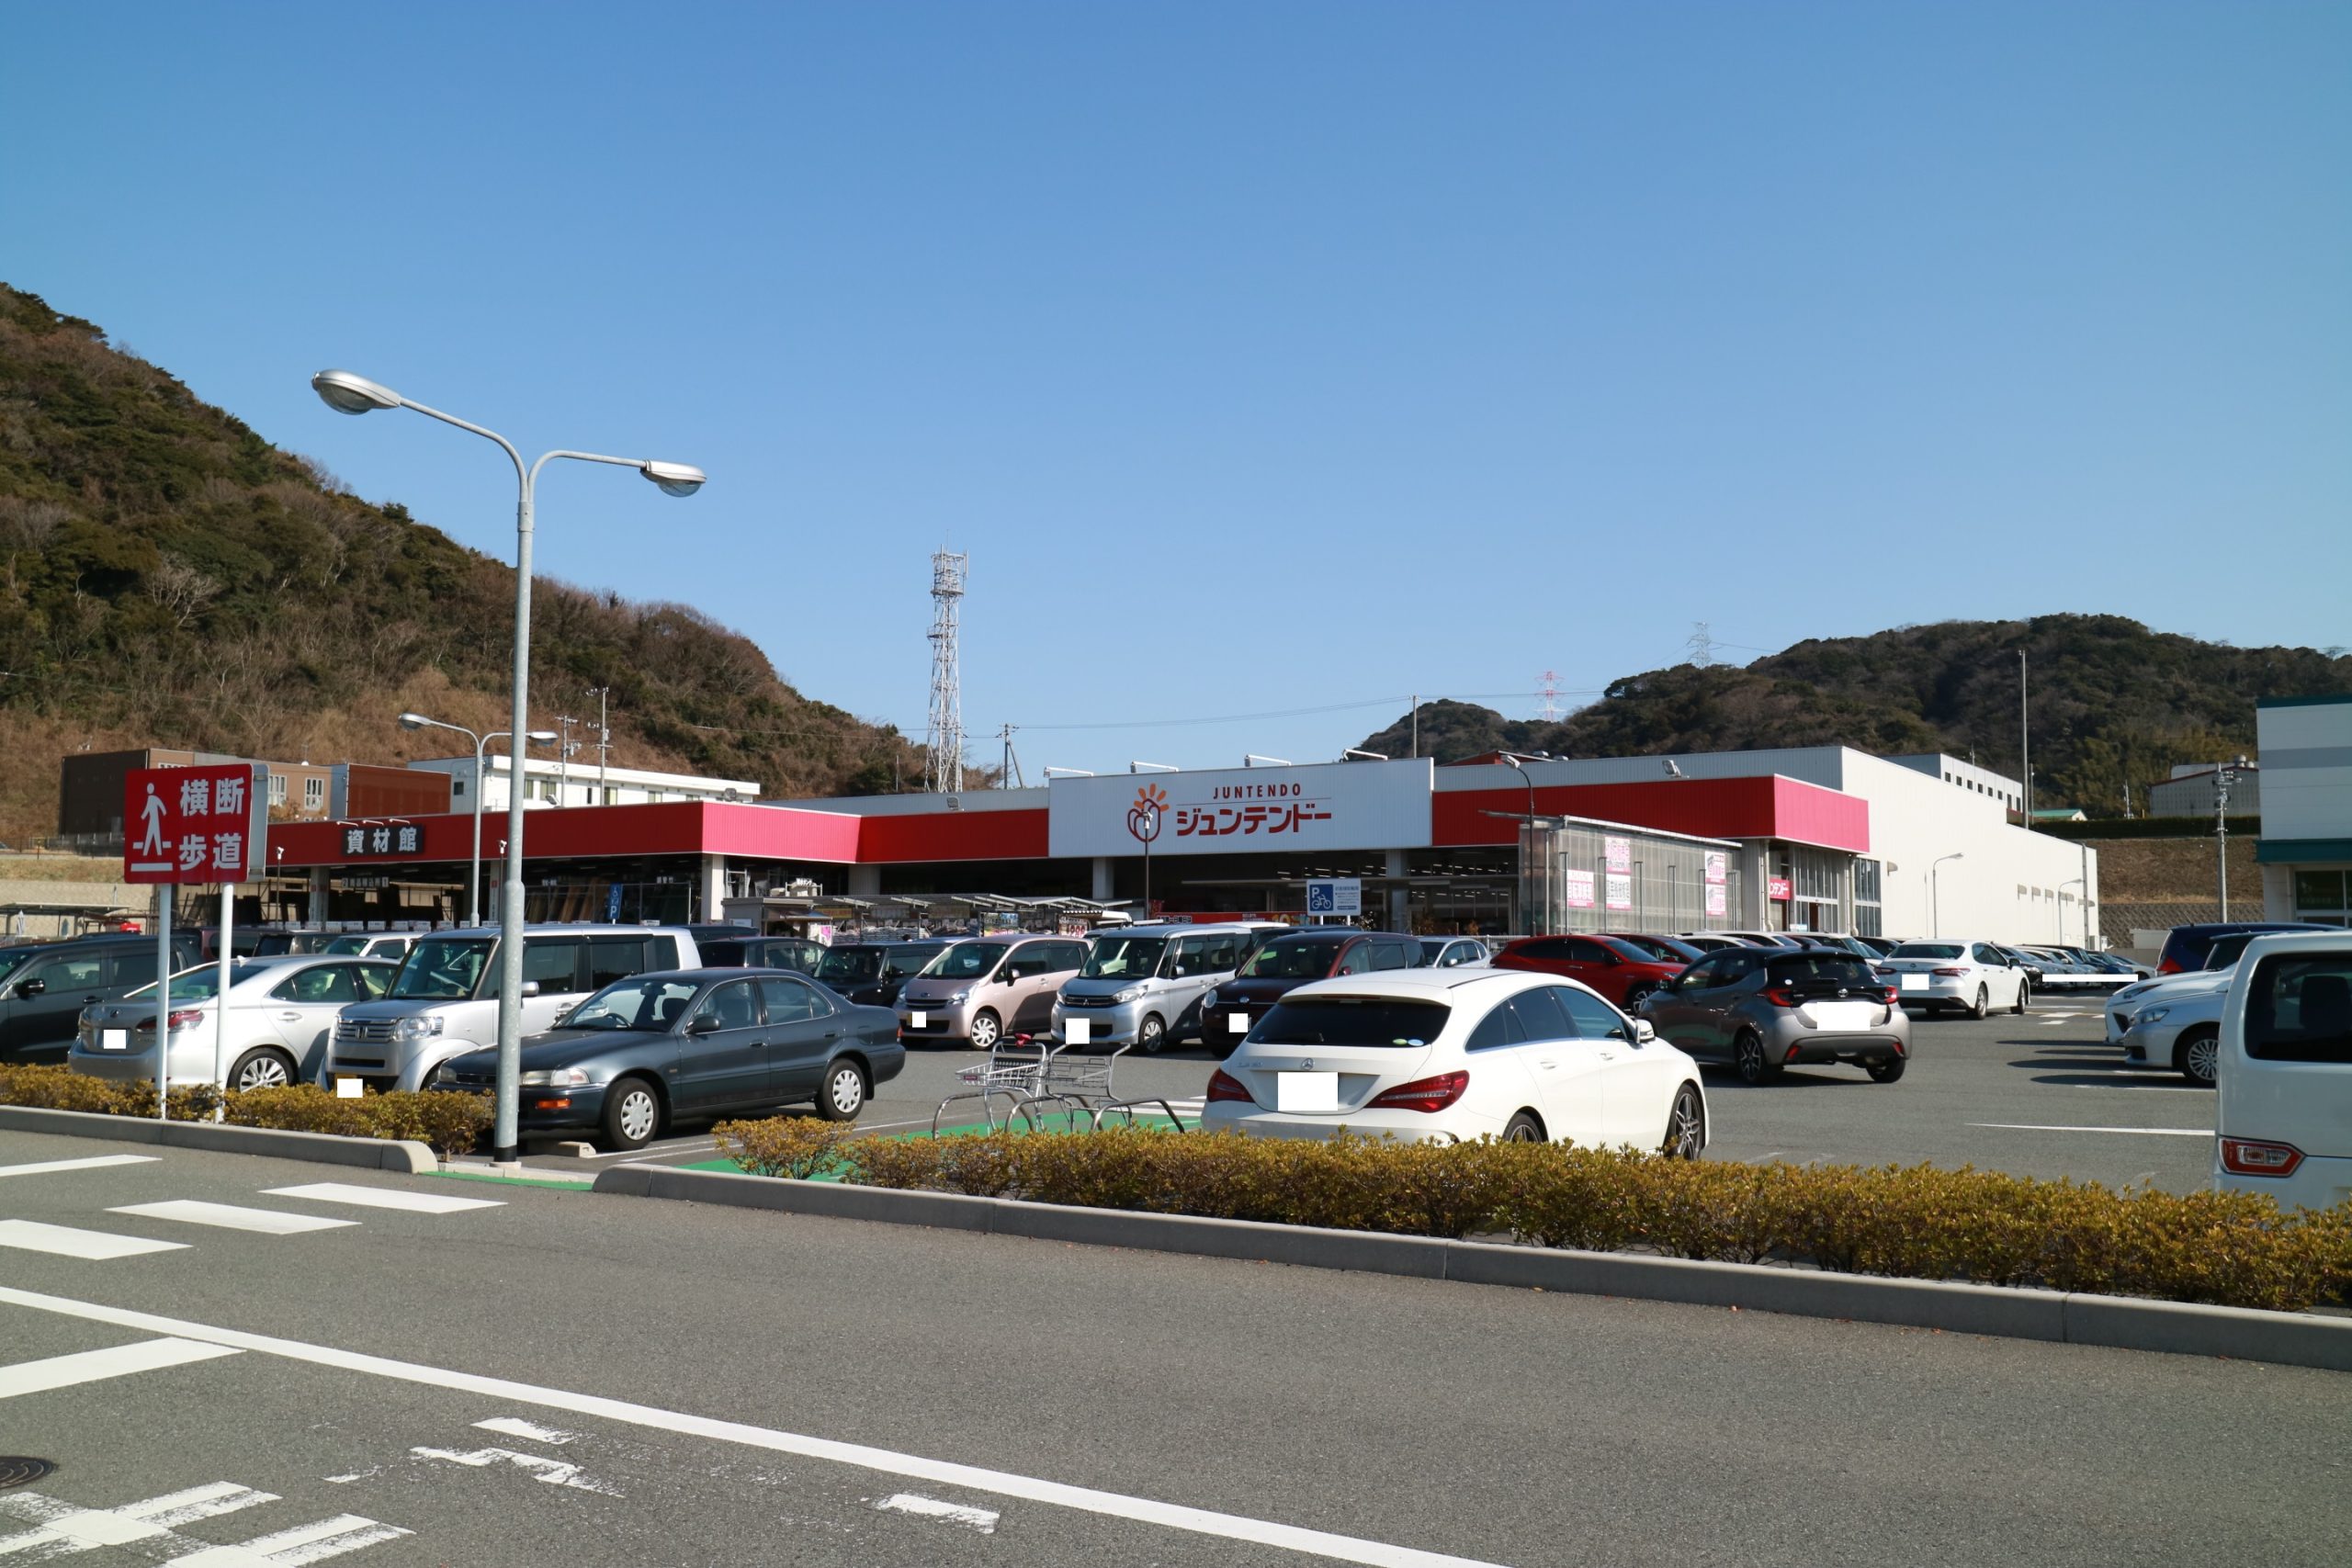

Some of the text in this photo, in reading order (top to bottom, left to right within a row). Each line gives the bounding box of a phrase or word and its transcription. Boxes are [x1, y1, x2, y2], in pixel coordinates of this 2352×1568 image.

[179, 777, 244, 817] 横断
[1213, 784, 1301, 800] JUNTENDO
[1177, 804, 1331, 836] ジュンテンドー
[178, 832, 243, 871] 歩道
[346, 828, 417, 854] 資材館
[1312, 887, 1319, 898] P
[610, 906, 616, 917] P
